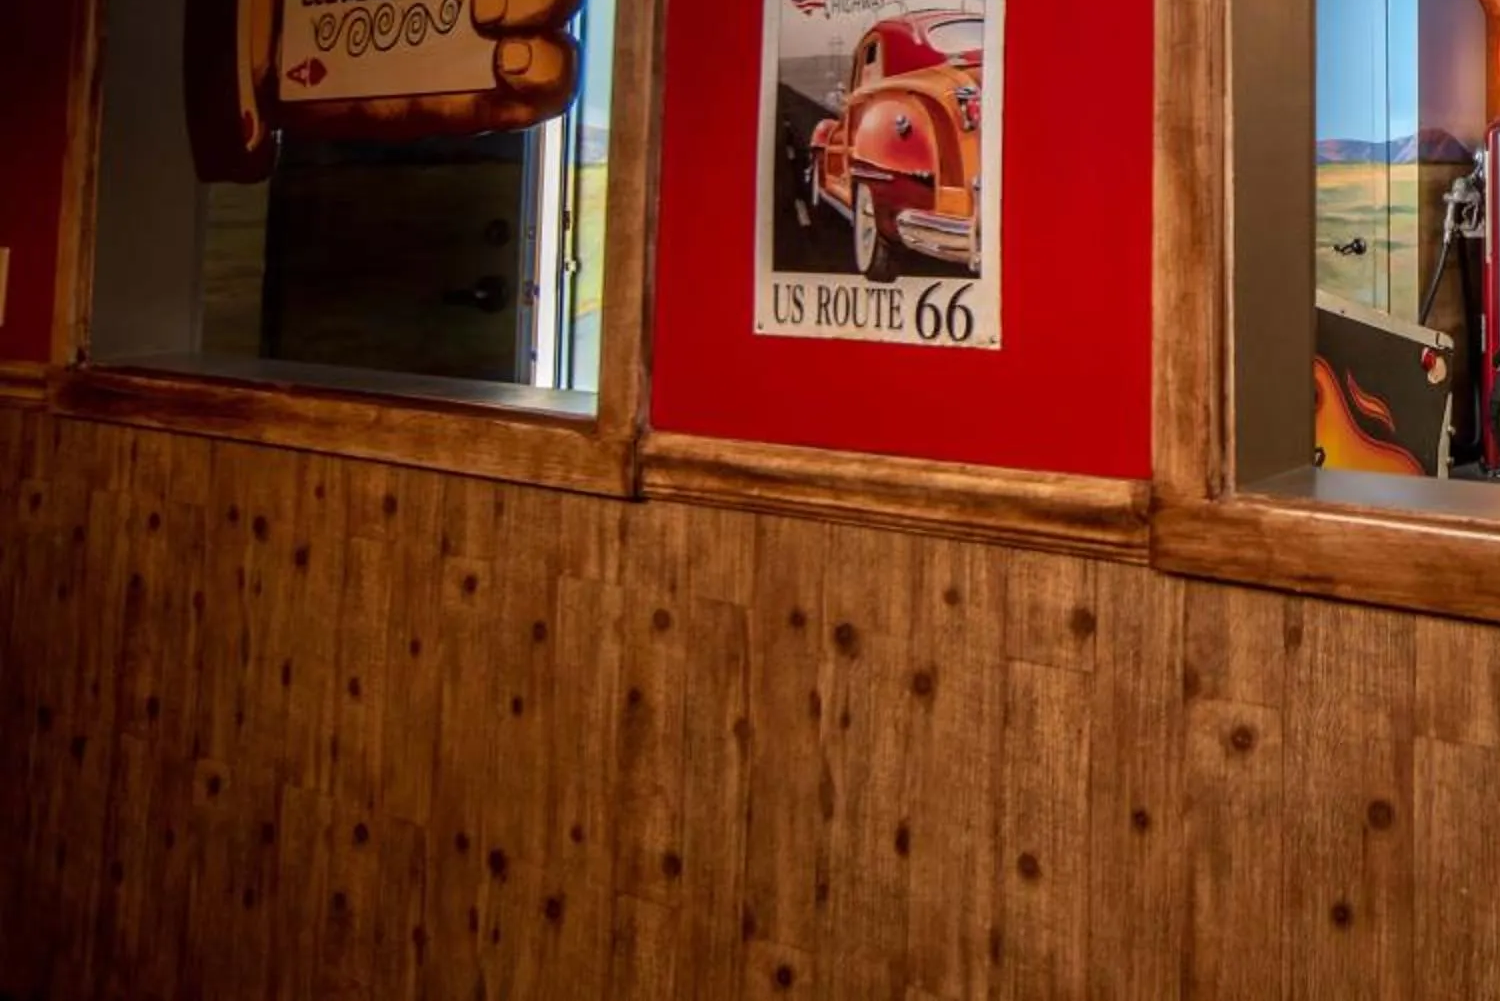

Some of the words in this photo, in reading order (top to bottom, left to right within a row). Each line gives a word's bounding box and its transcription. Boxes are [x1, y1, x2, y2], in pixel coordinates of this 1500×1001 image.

[772, 283, 805, 325] US
[815, 284, 905, 331] ROUTE
[914, 280, 975, 342] 66
